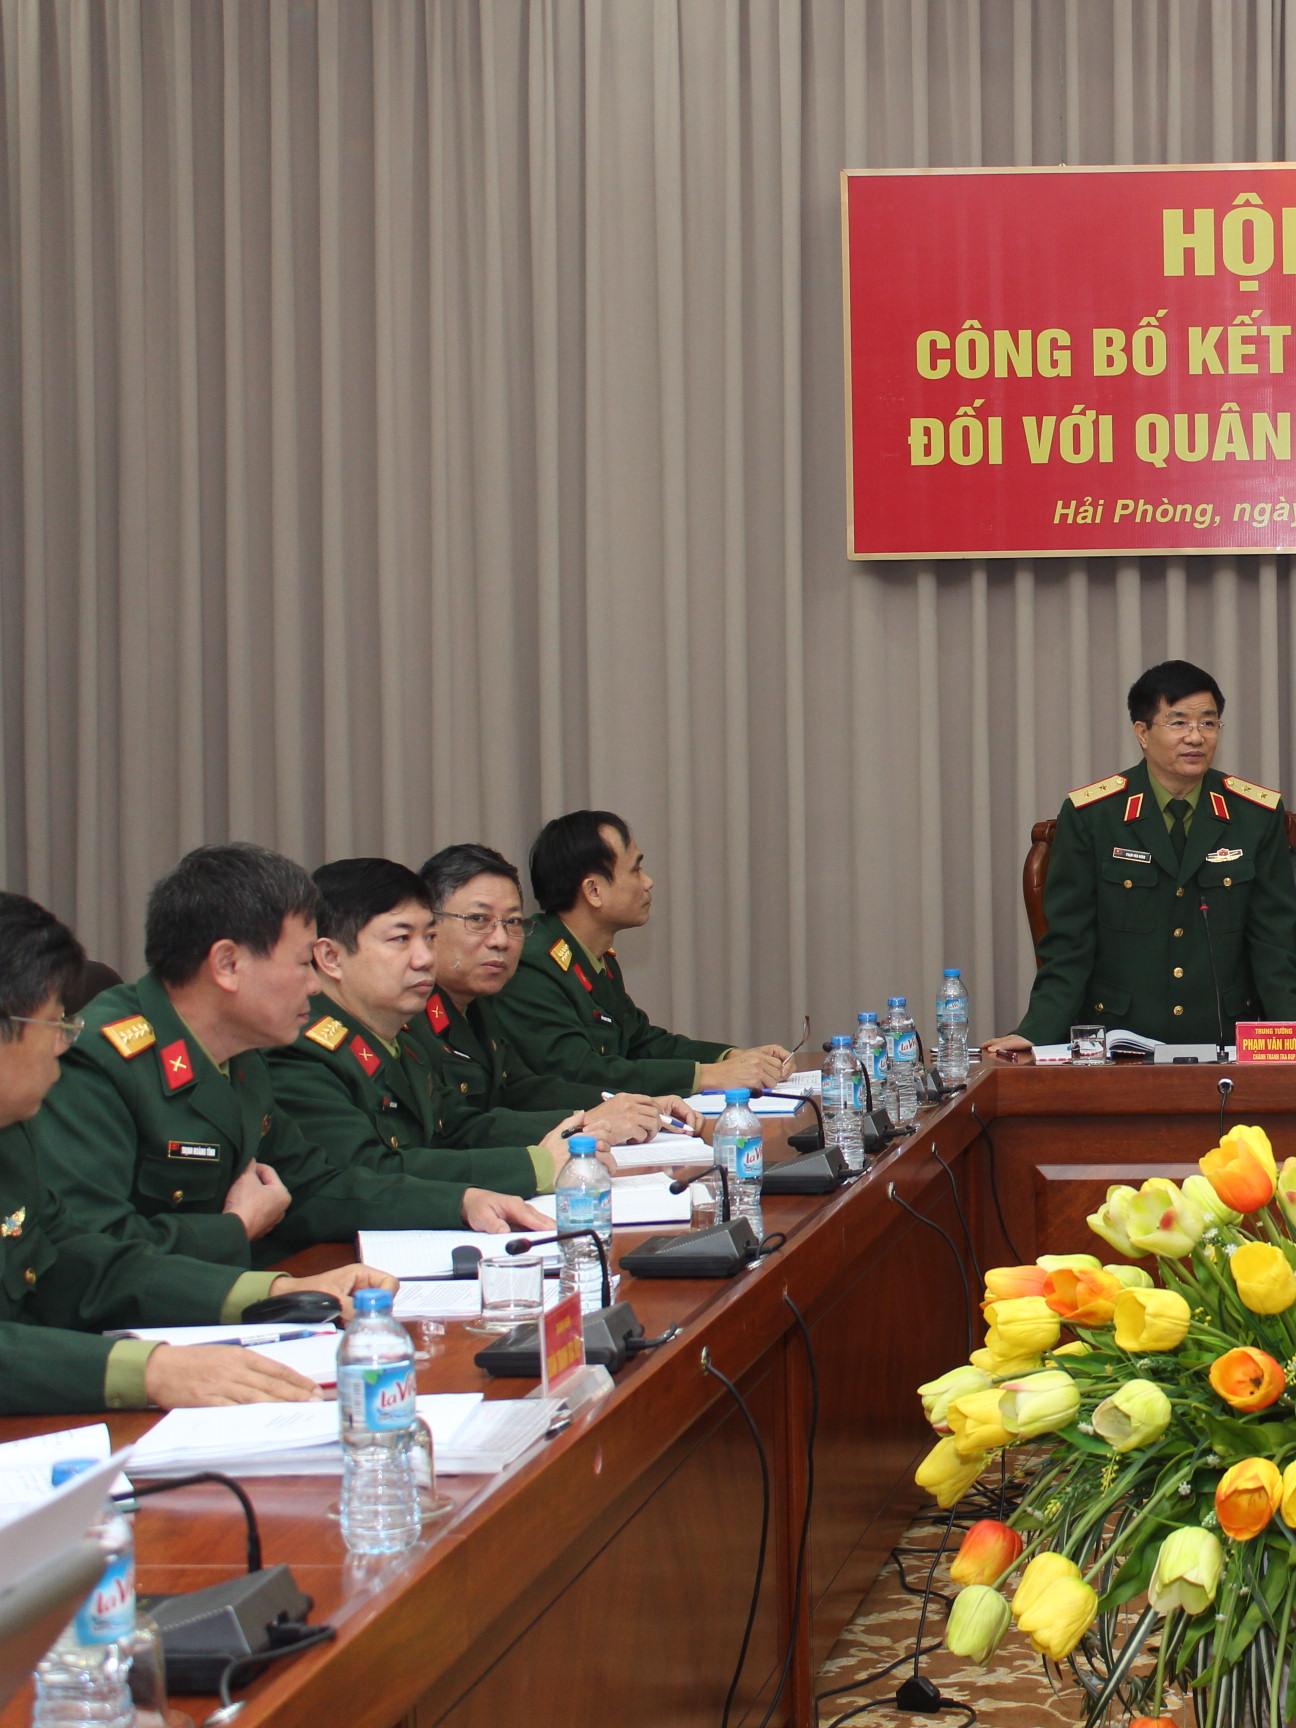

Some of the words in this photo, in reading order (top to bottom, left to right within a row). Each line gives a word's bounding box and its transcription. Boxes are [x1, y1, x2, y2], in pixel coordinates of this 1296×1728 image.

[916, 319, 1072, 379] CÔNG
[1093, 309, 1168, 377] BỐ
[1189, 309, 1293, 376] KẾT
[907, 399, 1003, 466] ĐỐI
[1021, 405, 1114, 464] VỚI
[1136, 402, 1293, 468] QUÂN
[1053, 496, 1105, 524] Hải
[1113, 497, 1222, 529] Phòng,
[1242, 1038, 1265, 1053] PHẠM
[1267, 1036, 1283, 1050] VĂN
